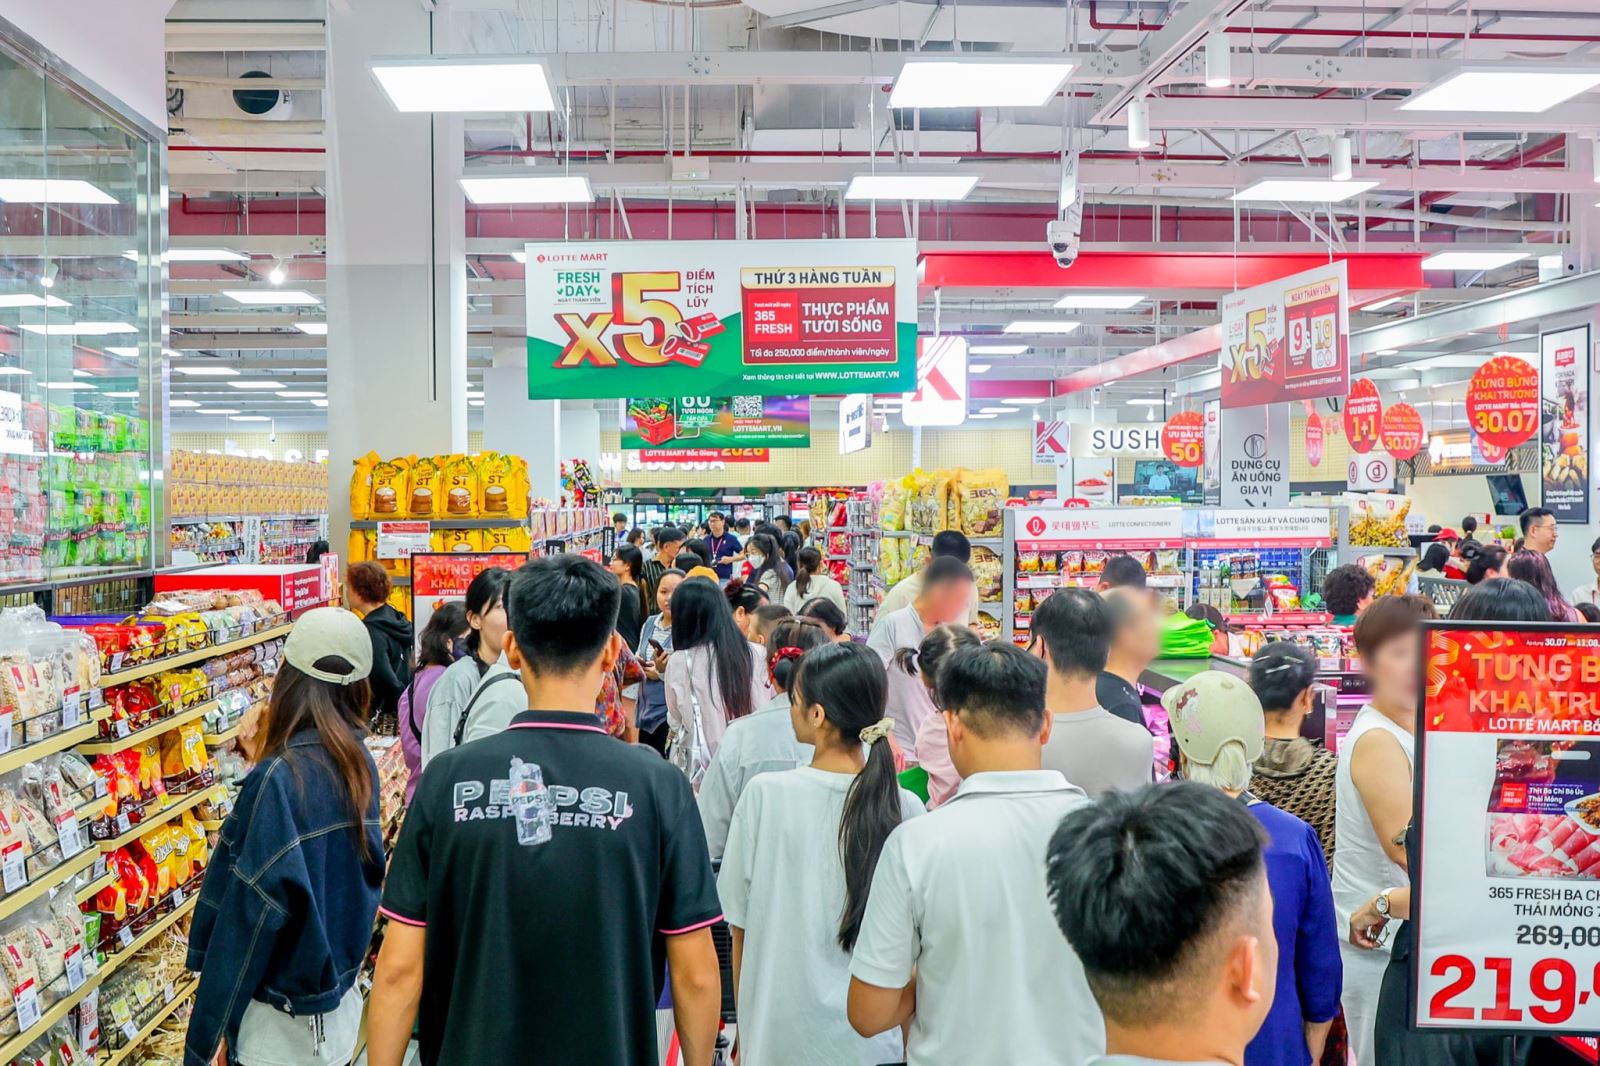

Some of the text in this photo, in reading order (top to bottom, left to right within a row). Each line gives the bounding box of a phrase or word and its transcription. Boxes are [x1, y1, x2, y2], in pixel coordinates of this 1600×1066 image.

[580, 253, 608, 261] MART
[557, 271, 600, 284] FRESH
[686, 268, 715, 280] ĐIỂM
[754, 267, 881, 285] THỨ 3 HÀNG TUẦN
[565, 285, 593, 297] DAY
[686, 283, 713, 294] TÍCH
[687, 298, 708, 308] LŨY
[802, 298, 889, 318] THỰC PHẨM
[754, 311, 775, 321] 365
[754, 323, 792, 334] FRESH
[802, 316, 882, 333] TƯƠI SỐNG
[1294, 322, 1303, 351] 9
[1314, 318, 1333, 350] 19
[774, 348, 806, 357] 250,000
[815, 371, 900, 380] WWW.LOTTEMART.VN
[1474, 389, 1538, 401] KHAI TRƯƠNG
[1475, 409, 1537, 433] 30.07
[1352, 414, 1378, 442] 1+1
[1385, 436, 1419, 450] 30.07
[1231, 460, 1280, 472] DỤNG CỤ
[1231, 469, 1281, 482] ĂN UỐNG
[1240, 485, 1273, 497] GIA VỊ
[1216, 514, 1328, 525] LOTTE SẢN XUẤT VÀ CUNG ỨNG
[454, 531, 470, 541] ST
[493, 533, 509, 544] ST
[431, 579, 459, 589] KHAI
[1544, 638, 1567, 647] 30.07
[1471, 653, 1572, 682] TƯNG
[1468, 690, 1544, 715] KHAI
[1489, 718, 1534, 731] LOTTE
[1537, 719, 1580, 732] MART
[453, 779, 629, 819] PEPSI
[1488, 886, 1514, 899] 365
[1516, 887, 1561, 901] FRESH
[1564, 889, 1583, 901] BA
[1514, 902, 1593, 918] THÁI MỎNG
[1429, 954, 1600, 1025] 219,
